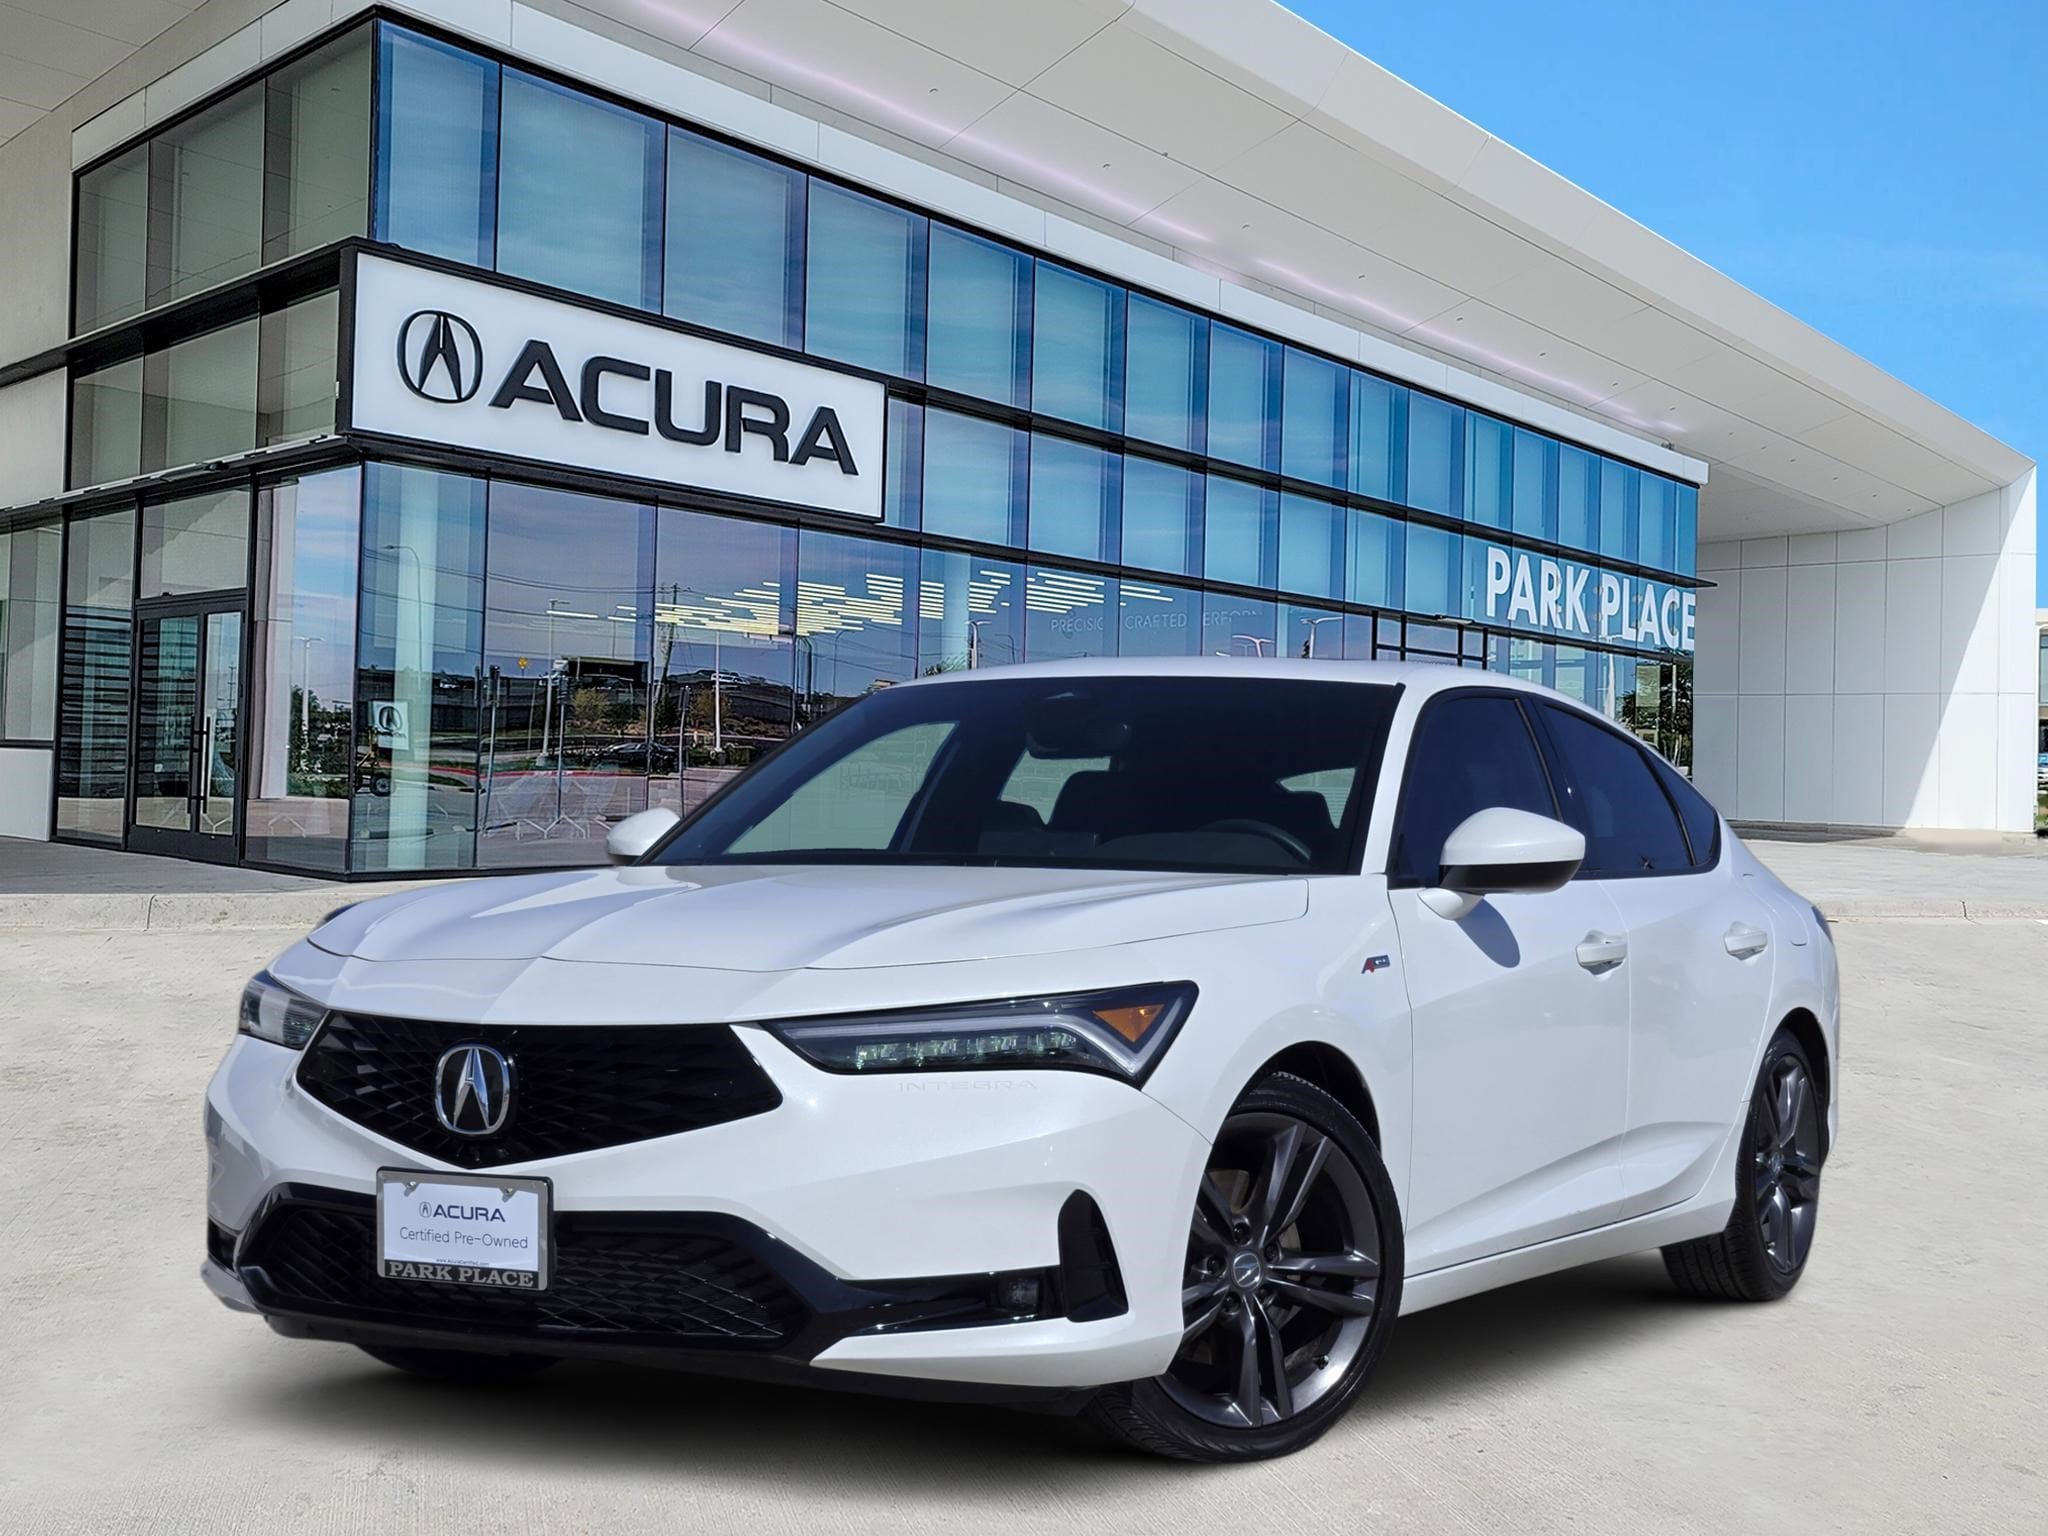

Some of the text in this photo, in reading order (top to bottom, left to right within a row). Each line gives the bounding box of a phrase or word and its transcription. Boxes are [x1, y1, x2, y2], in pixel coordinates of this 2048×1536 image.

[488, 338, 859, 476] ACURA
[1486, 546, 1696, 650] PARK PLACE
[1124, 612, 1187, 630] CRAFTED
[898, 1079, 1038, 1093] INTEGRA
[433, 1203, 506, 1223] ACURA
[400, 1226, 529, 1250] Certified Pre-Owned
[389, 1260, 534, 1287] PARK PLACE
